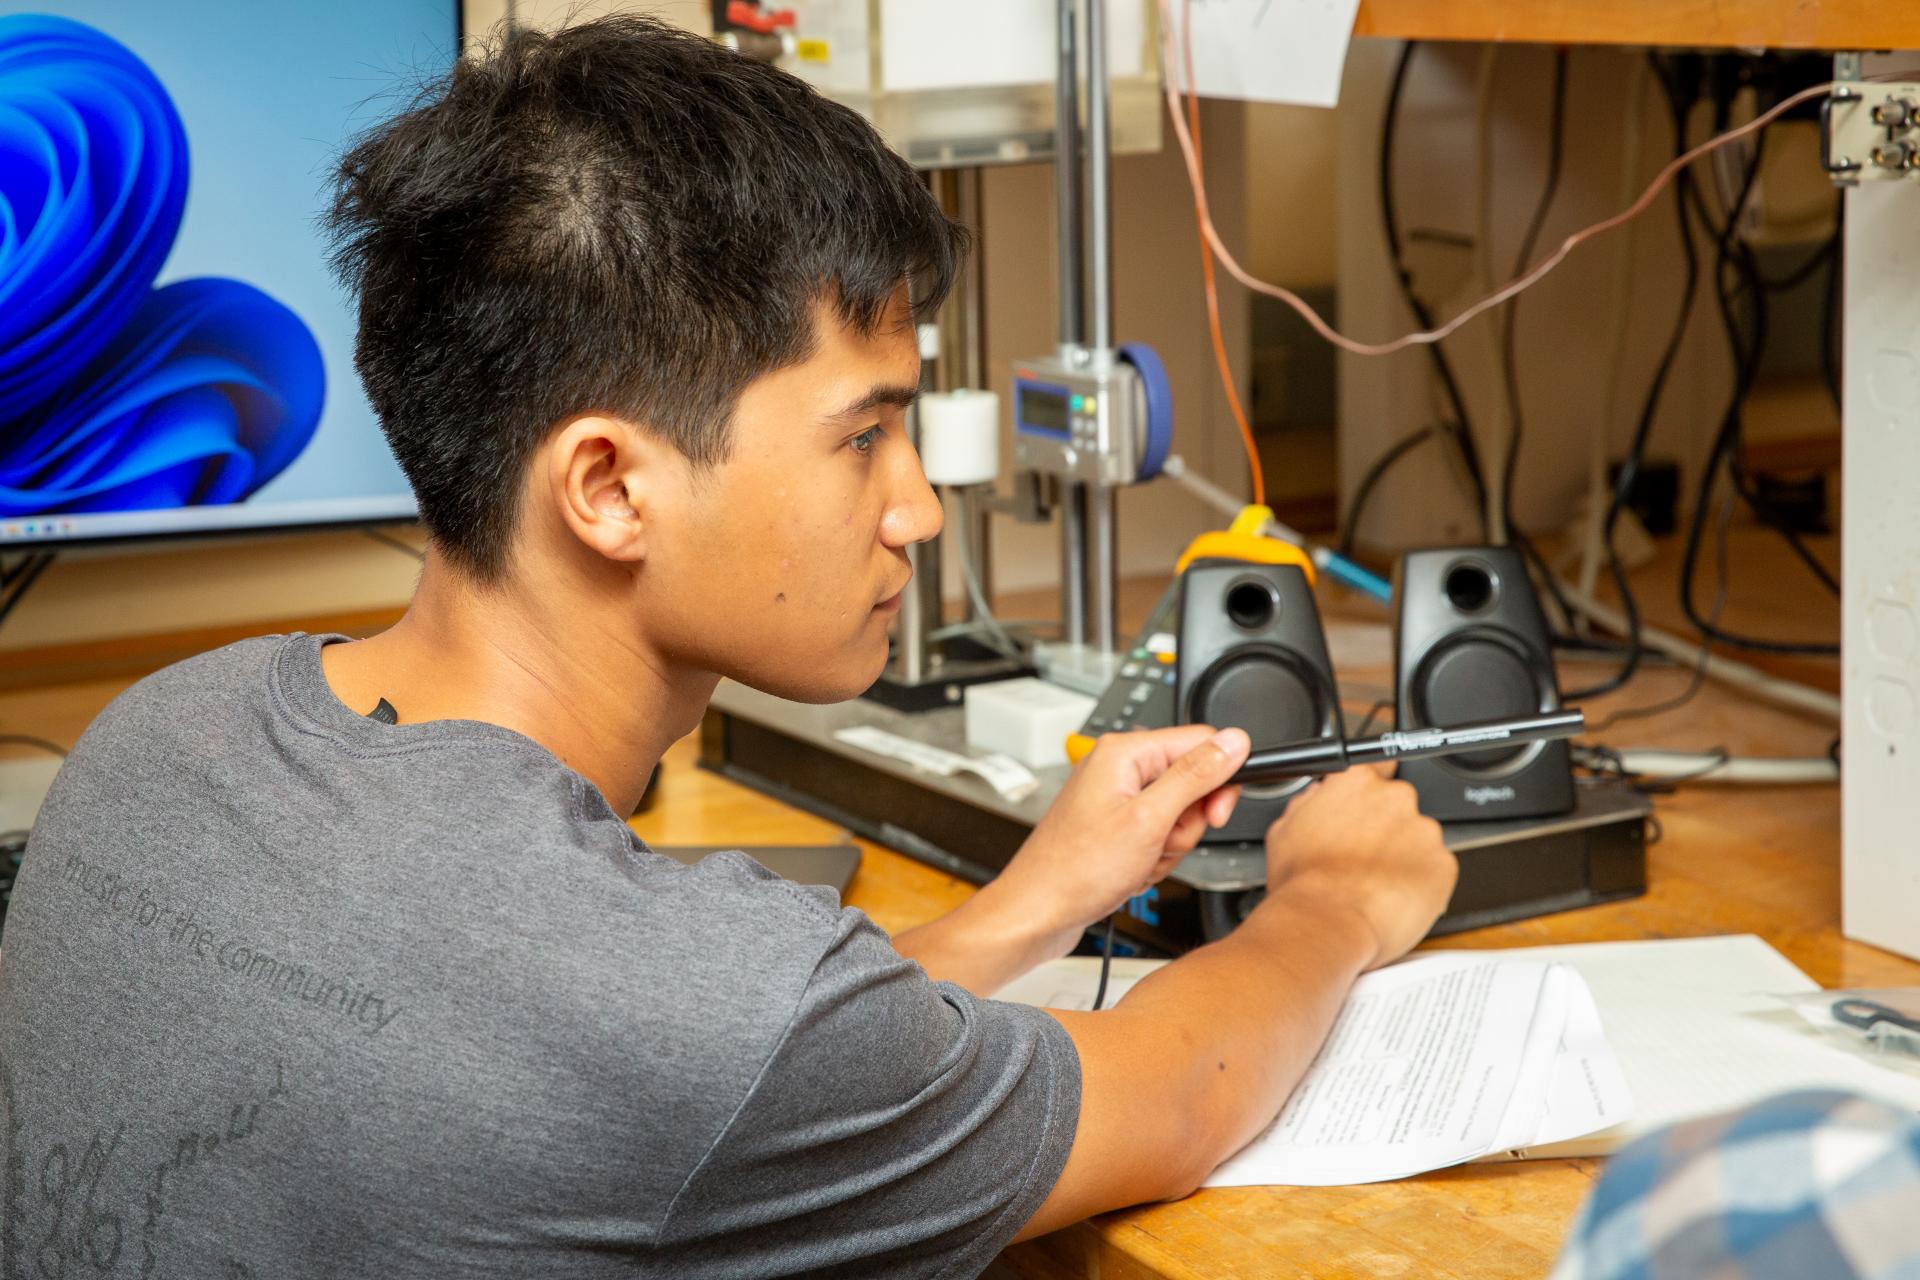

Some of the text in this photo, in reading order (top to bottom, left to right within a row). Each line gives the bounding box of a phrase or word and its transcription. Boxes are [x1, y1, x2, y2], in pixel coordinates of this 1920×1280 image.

[62, 854, 402, 1036] music for the community
